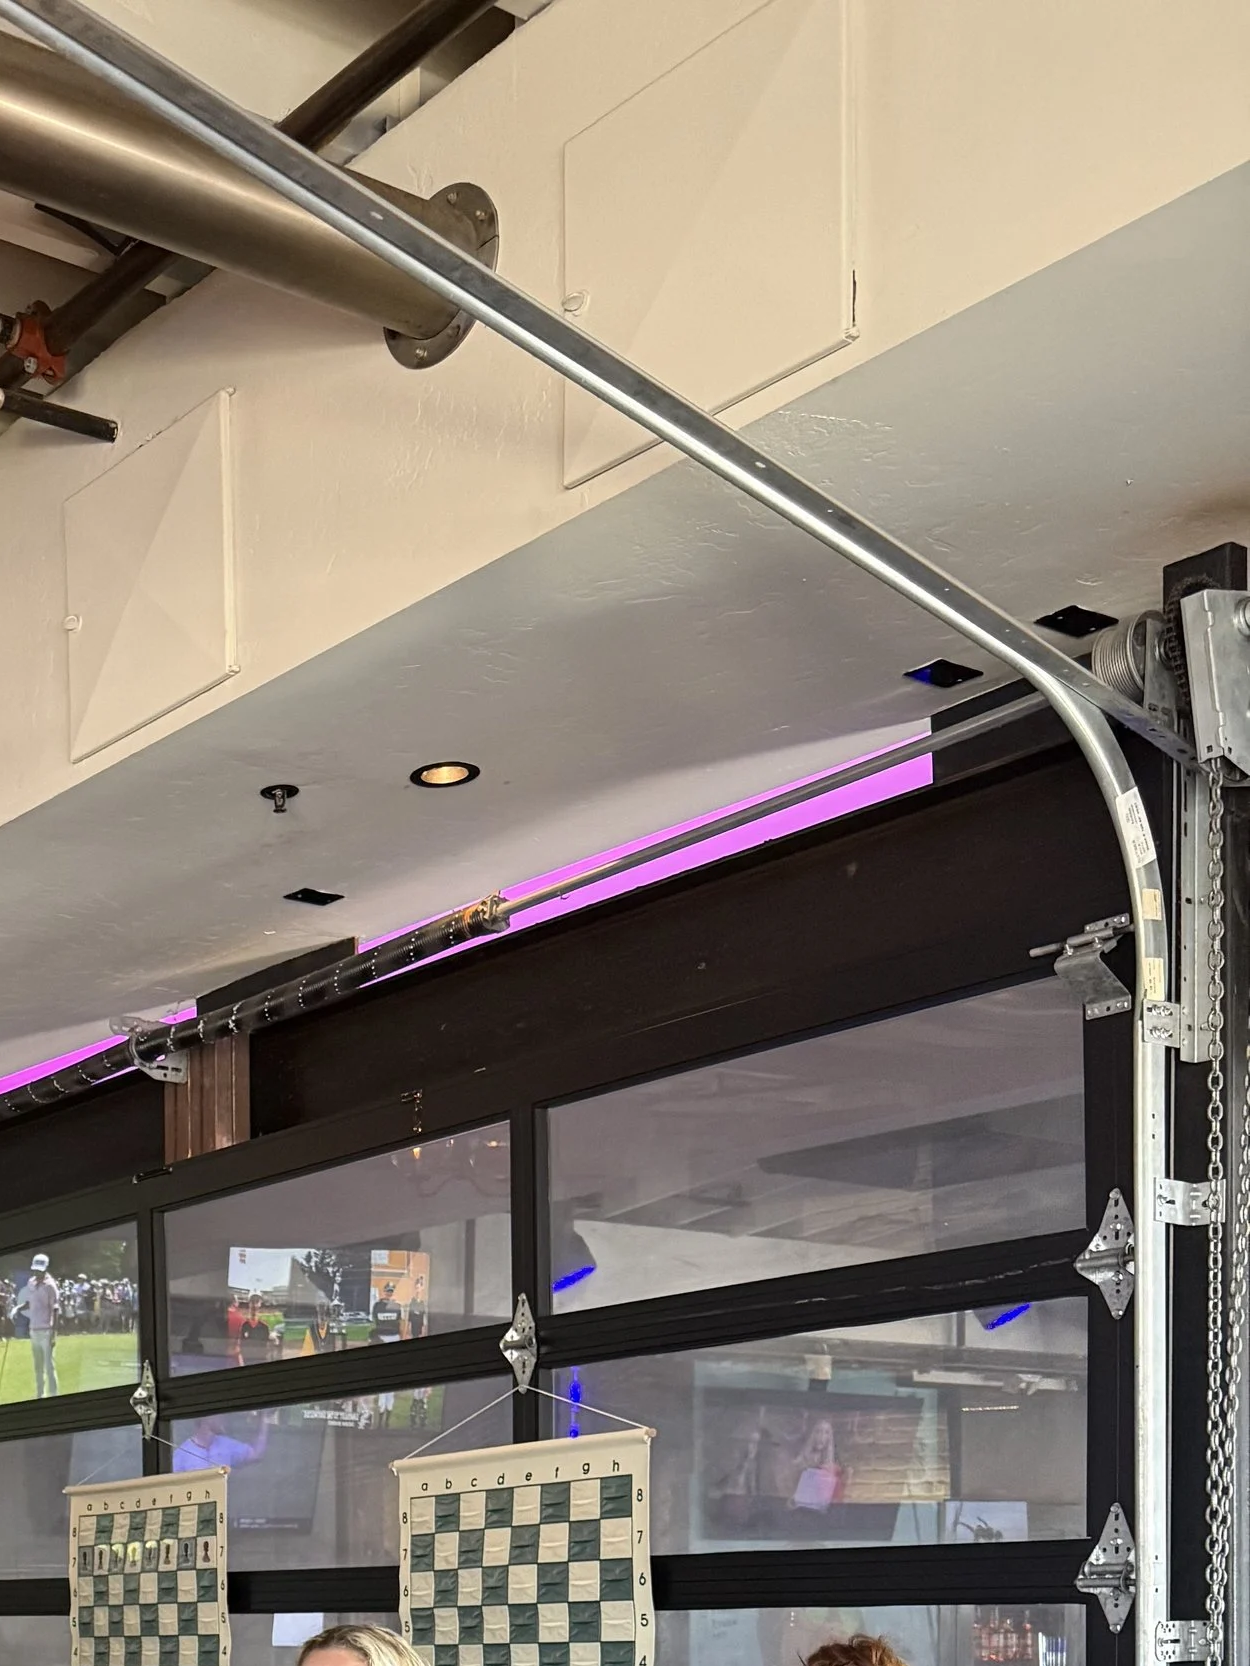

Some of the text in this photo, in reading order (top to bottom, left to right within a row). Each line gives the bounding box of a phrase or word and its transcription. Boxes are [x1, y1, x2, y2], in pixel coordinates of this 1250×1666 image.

[636, 1488, 644, 1503] 8
[636, 1529, 644, 1544] 7
[638, 1572, 647, 1586] 6
[640, 1613, 649, 1627] 5
